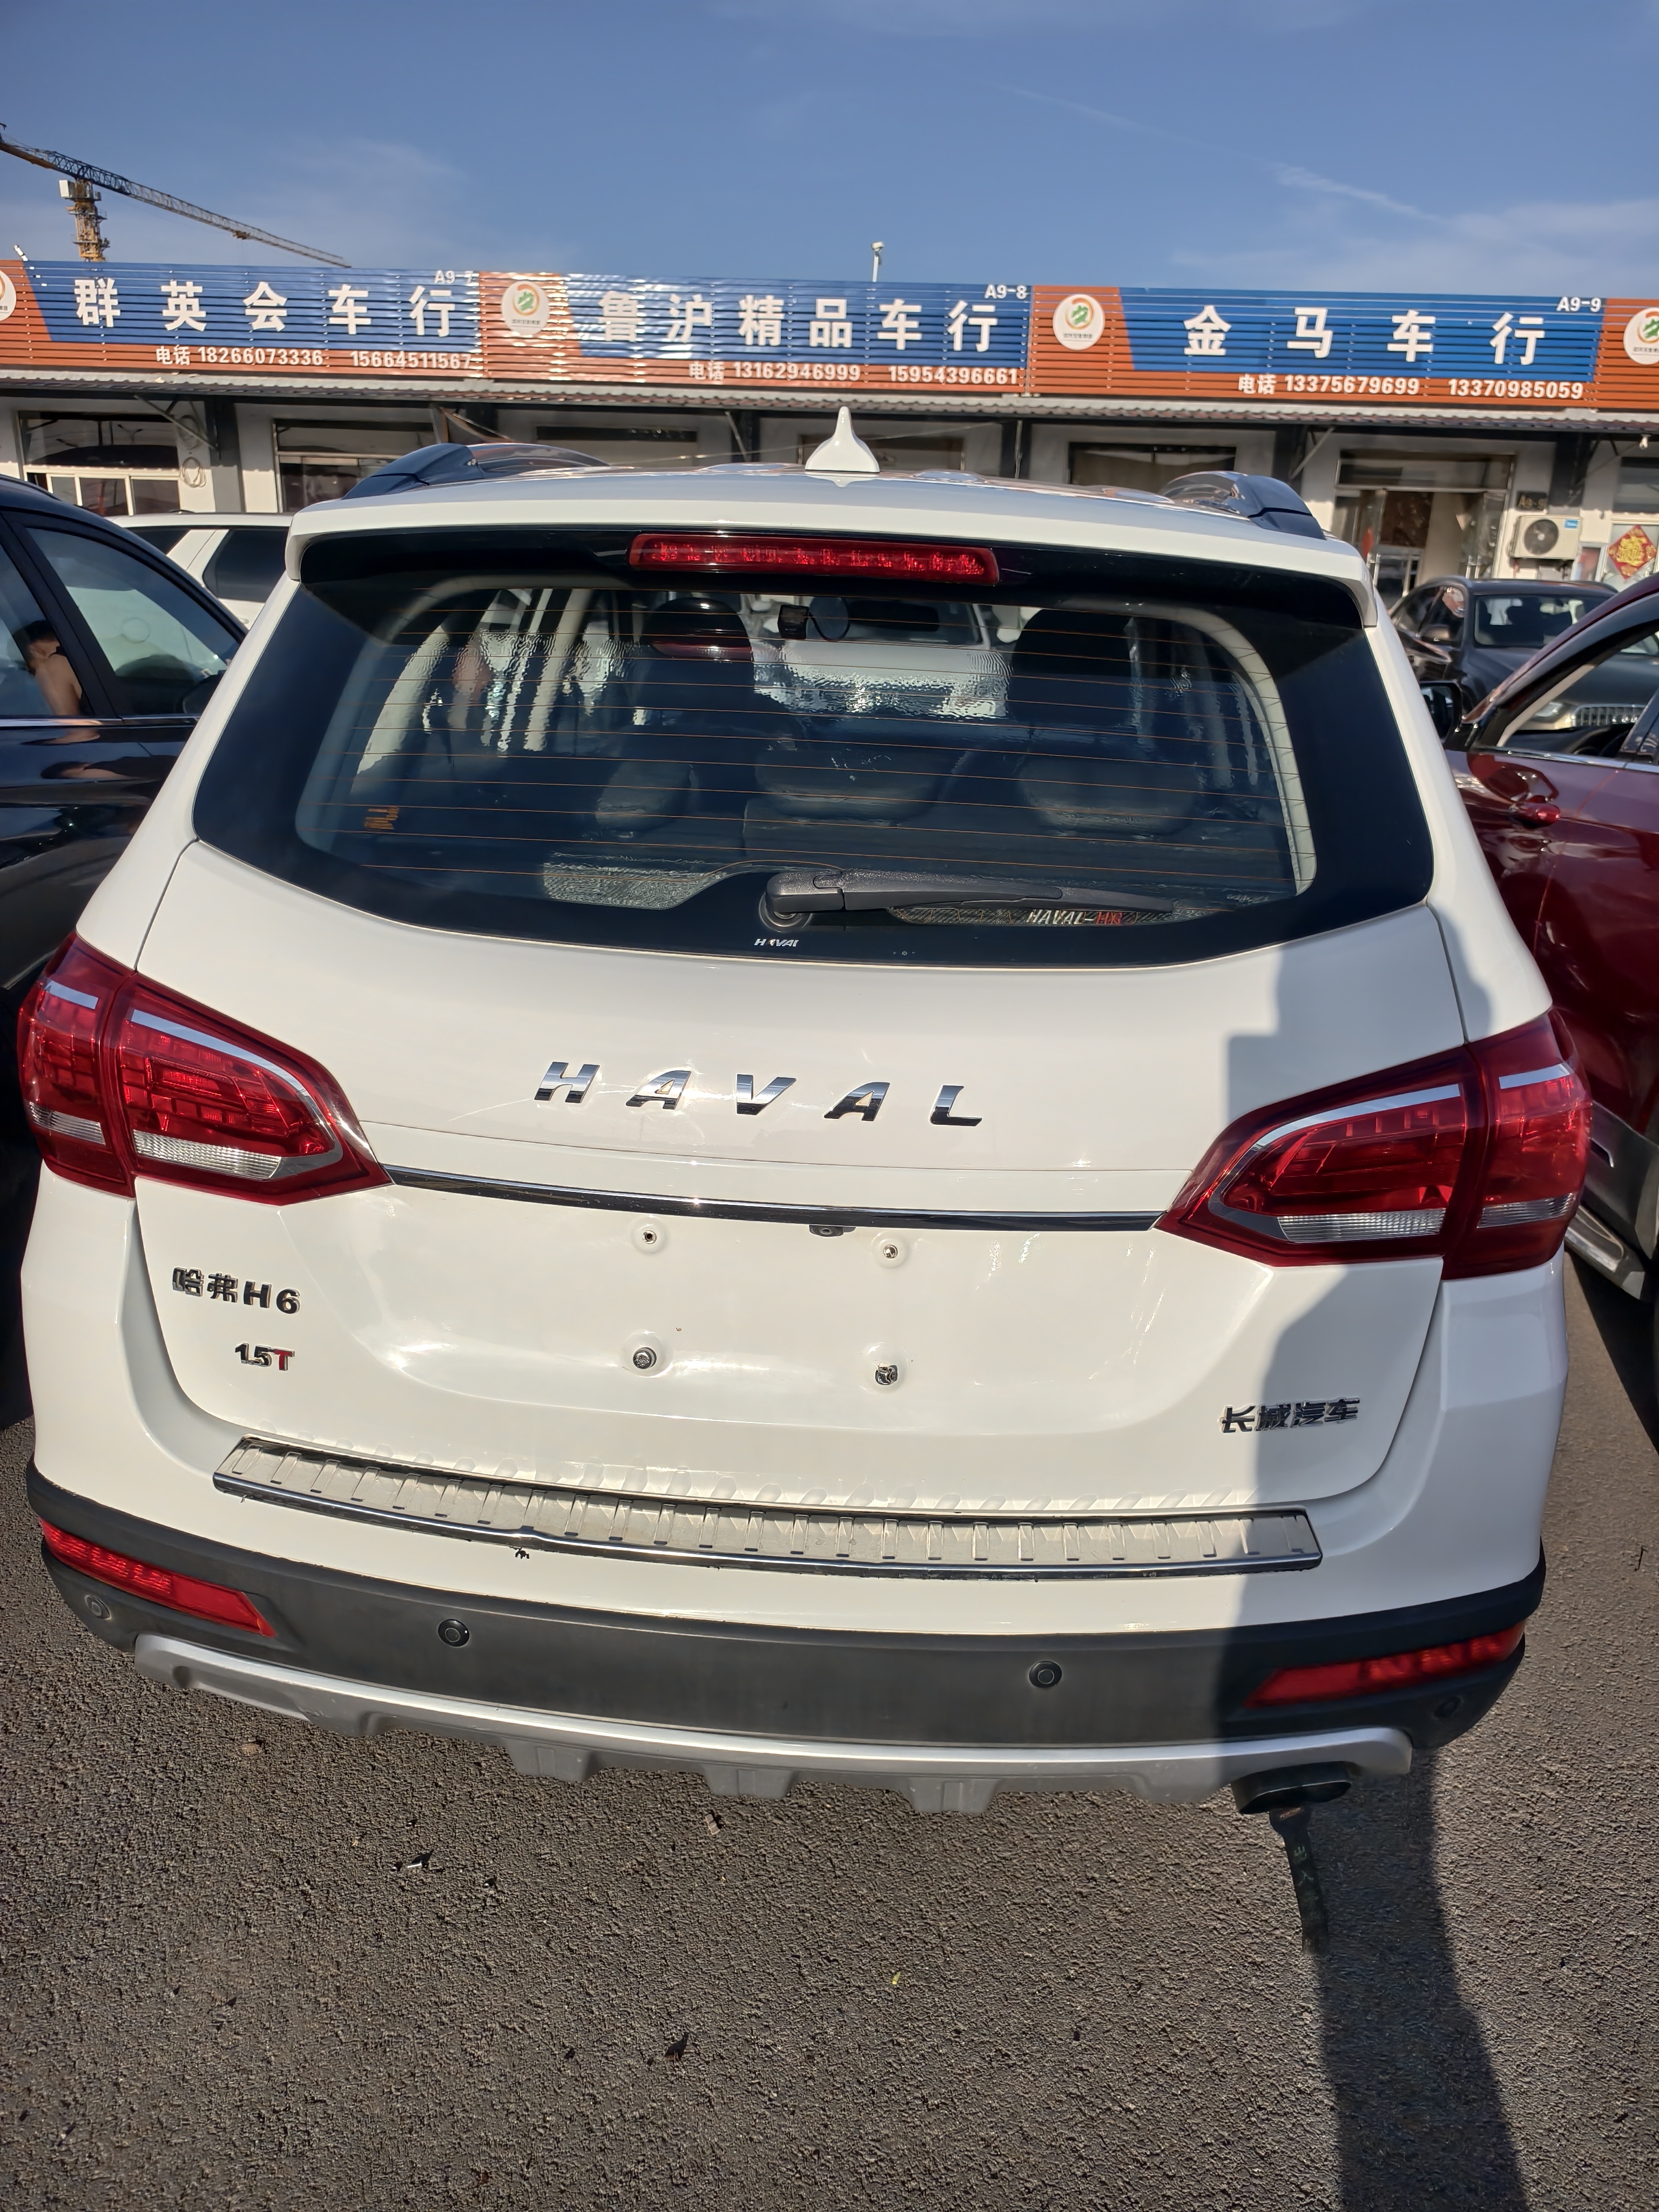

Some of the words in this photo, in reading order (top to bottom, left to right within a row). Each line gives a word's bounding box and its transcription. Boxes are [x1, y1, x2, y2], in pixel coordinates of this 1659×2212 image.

[434, 270, 474, 284] A9-7
[984, 285, 1027, 299] A9-8
[1556, 296, 1601, 312] A9-9
[74, 278, 455, 337] 群英会车行
[598, 291, 997, 352] 鲁沪精品车行
[1183, 305, 1546, 365] 金马车行
[156, 345, 191, 366] 电话
[198, 346, 323, 366] 18266073336
[350, 350, 471, 369] 15664511567
[689, 361, 725, 380] 电话
[733, 361, 861, 381] 13162946999
[888, 365, 1018, 385] 15954396661
[1238, 373, 1277, 395] 电话
[1285, 374, 1420, 395] 13375679699
[1448, 378, 1584, 399] 13370985059
[534, 1061, 982, 1127] HAVAL
[1219, 1397, 1360, 1433] 长城汽车
